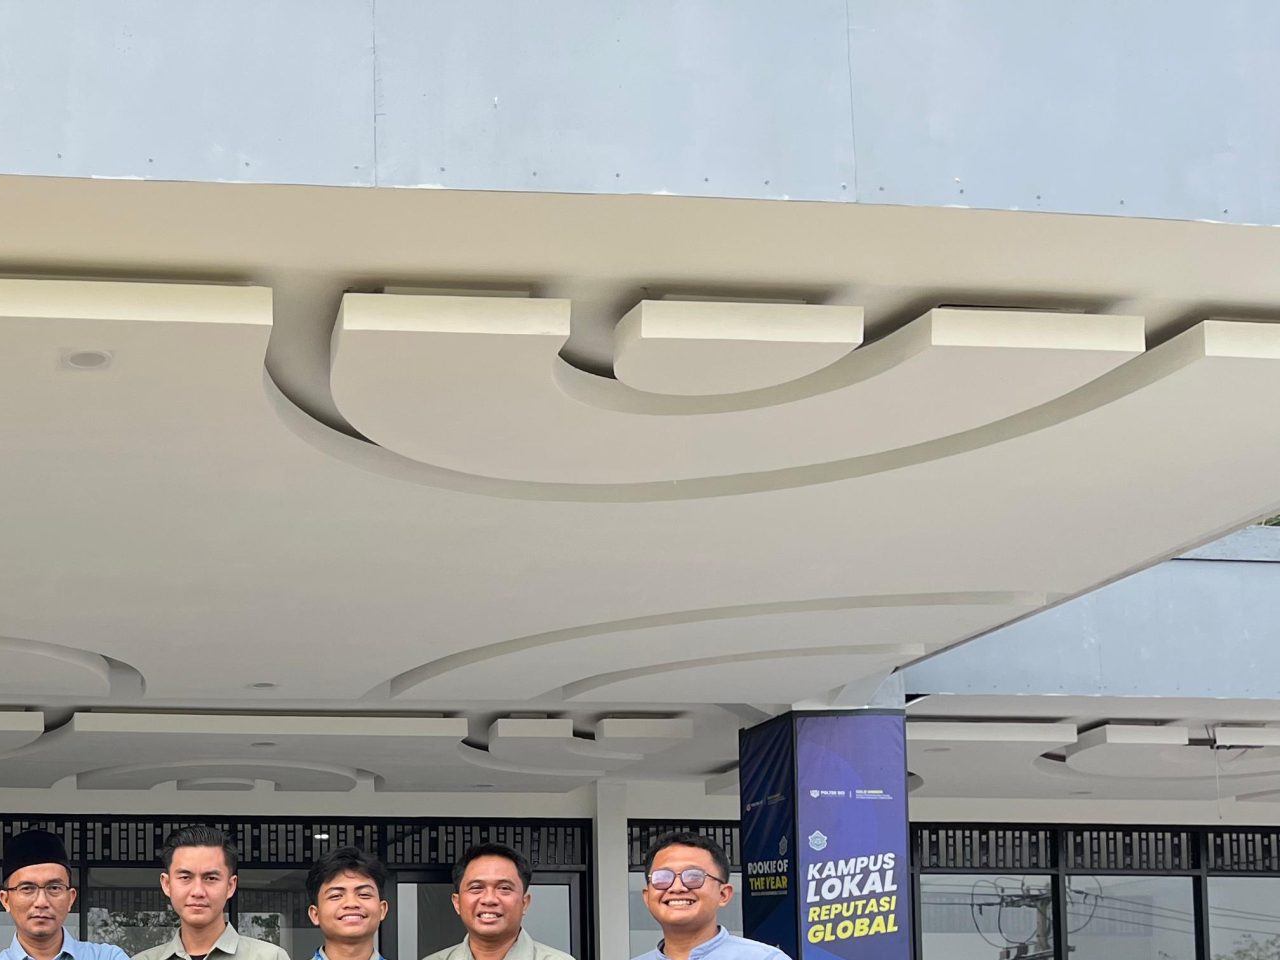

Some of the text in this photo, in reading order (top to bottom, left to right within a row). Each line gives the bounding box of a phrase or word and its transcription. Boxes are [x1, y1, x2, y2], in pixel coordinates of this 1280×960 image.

[747, 859, 789, 875] ROOKIE OF
[807, 852, 896, 880] KAMPUS
[749, 875, 788, 890] THE YEAR
[806, 869, 898, 903] LOKAL
[807, 895, 897, 922] REPUTASI
[807, 913, 899, 944] GLOBAL
